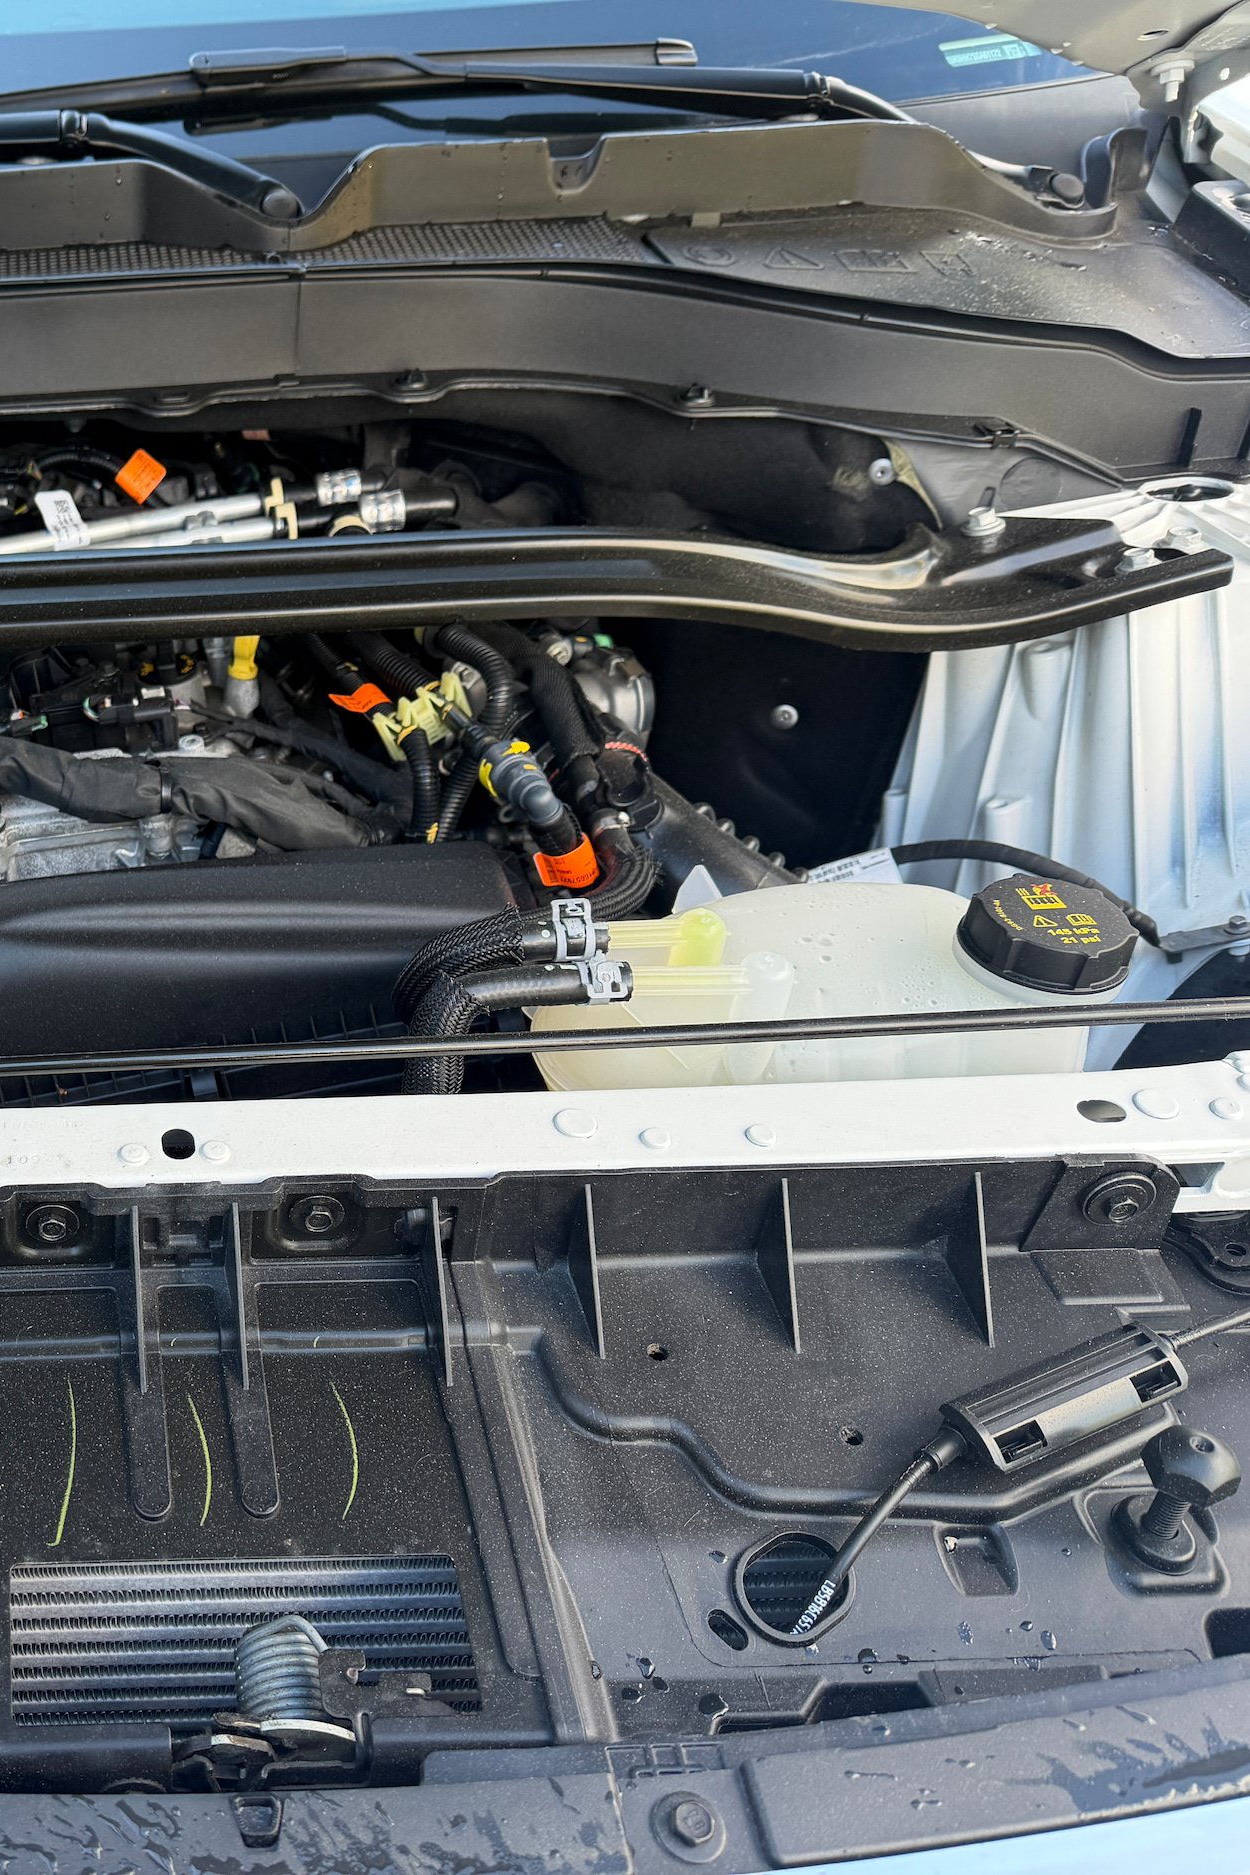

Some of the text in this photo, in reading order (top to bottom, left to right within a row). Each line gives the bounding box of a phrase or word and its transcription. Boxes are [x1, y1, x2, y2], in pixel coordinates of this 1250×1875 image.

[1047, 926, 1100, 936] 145 kPa
[1061, 935, 1102, 945] 21 psi
